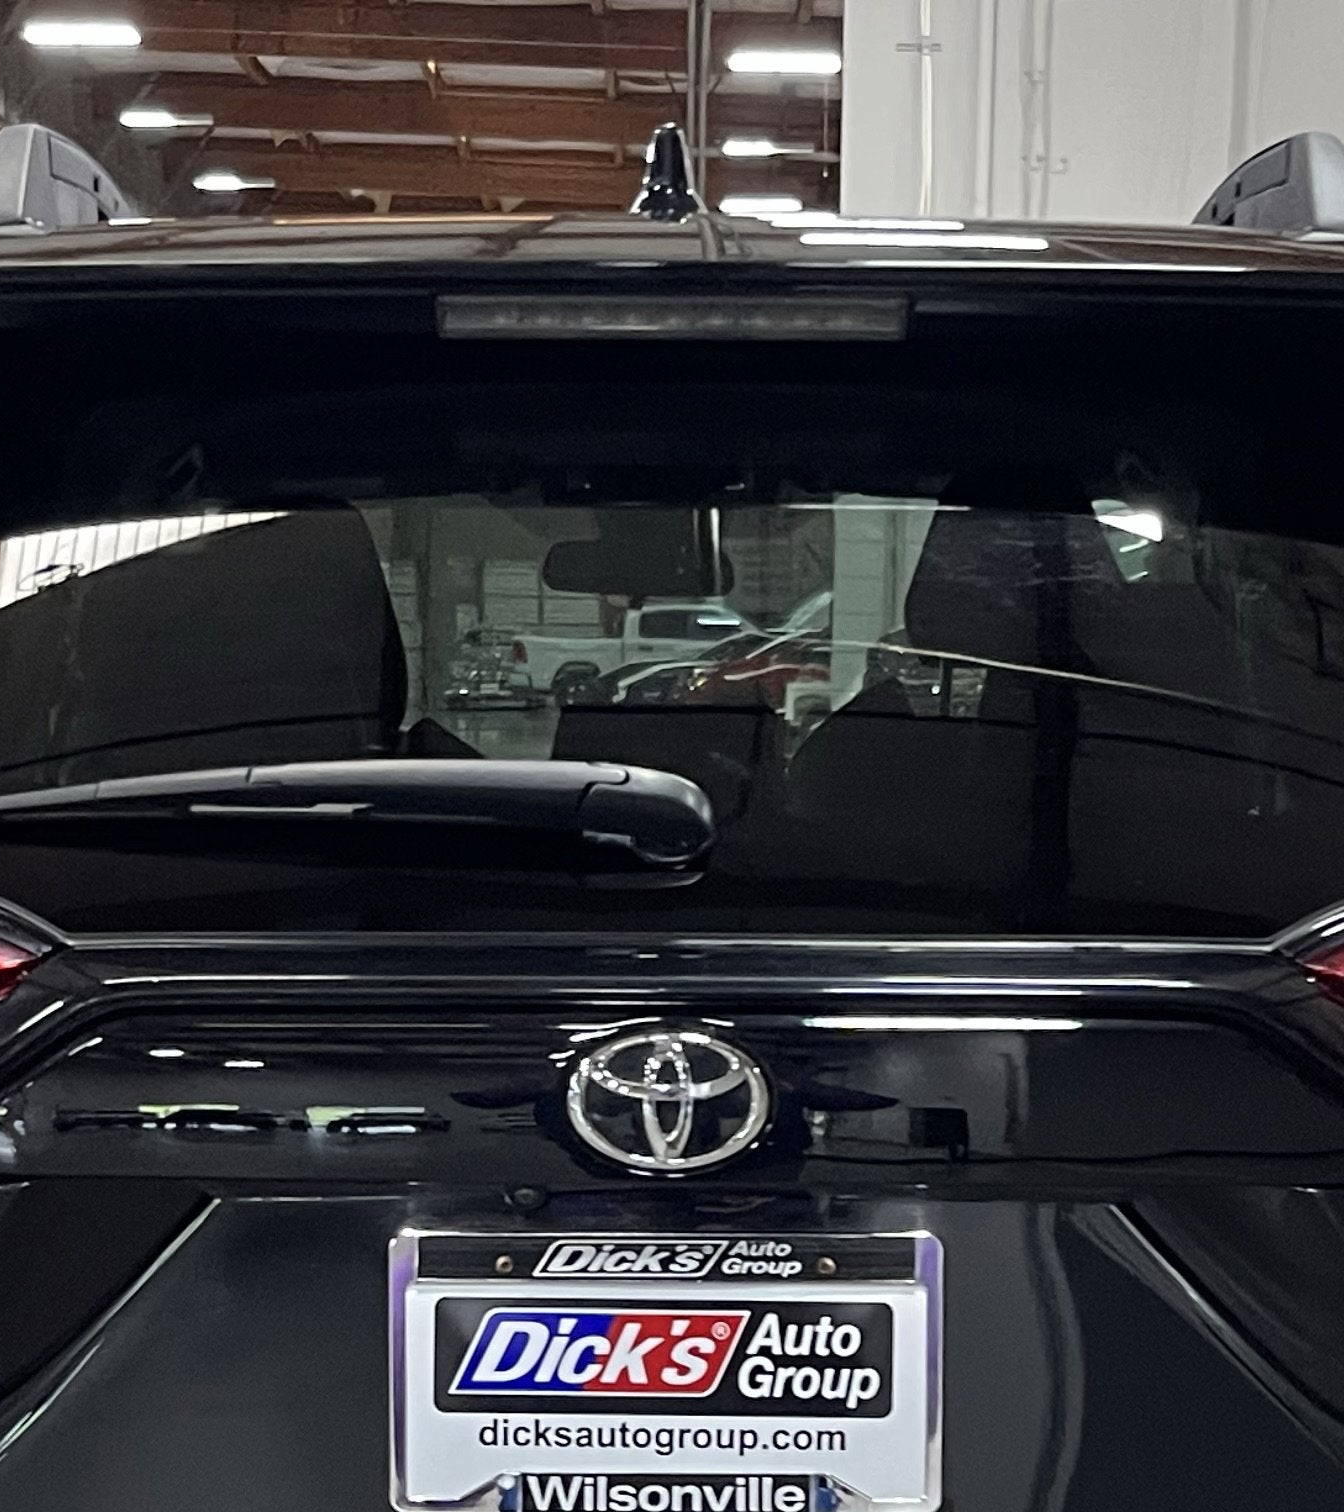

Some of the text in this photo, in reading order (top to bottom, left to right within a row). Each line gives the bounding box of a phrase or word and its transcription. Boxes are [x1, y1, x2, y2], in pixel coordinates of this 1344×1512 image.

[721, 1258, 803, 1278] Group
[728, 1241, 792, 1257] Auto
[471, 1317, 716, 1386] Dick's
[746, 1312, 862, 1357] Auto
[737, 1356, 881, 1409] Group
[478, 1419, 847, 1456] dicksautogroup.com
[527, 1474, 806, 1512] Wilsonville
